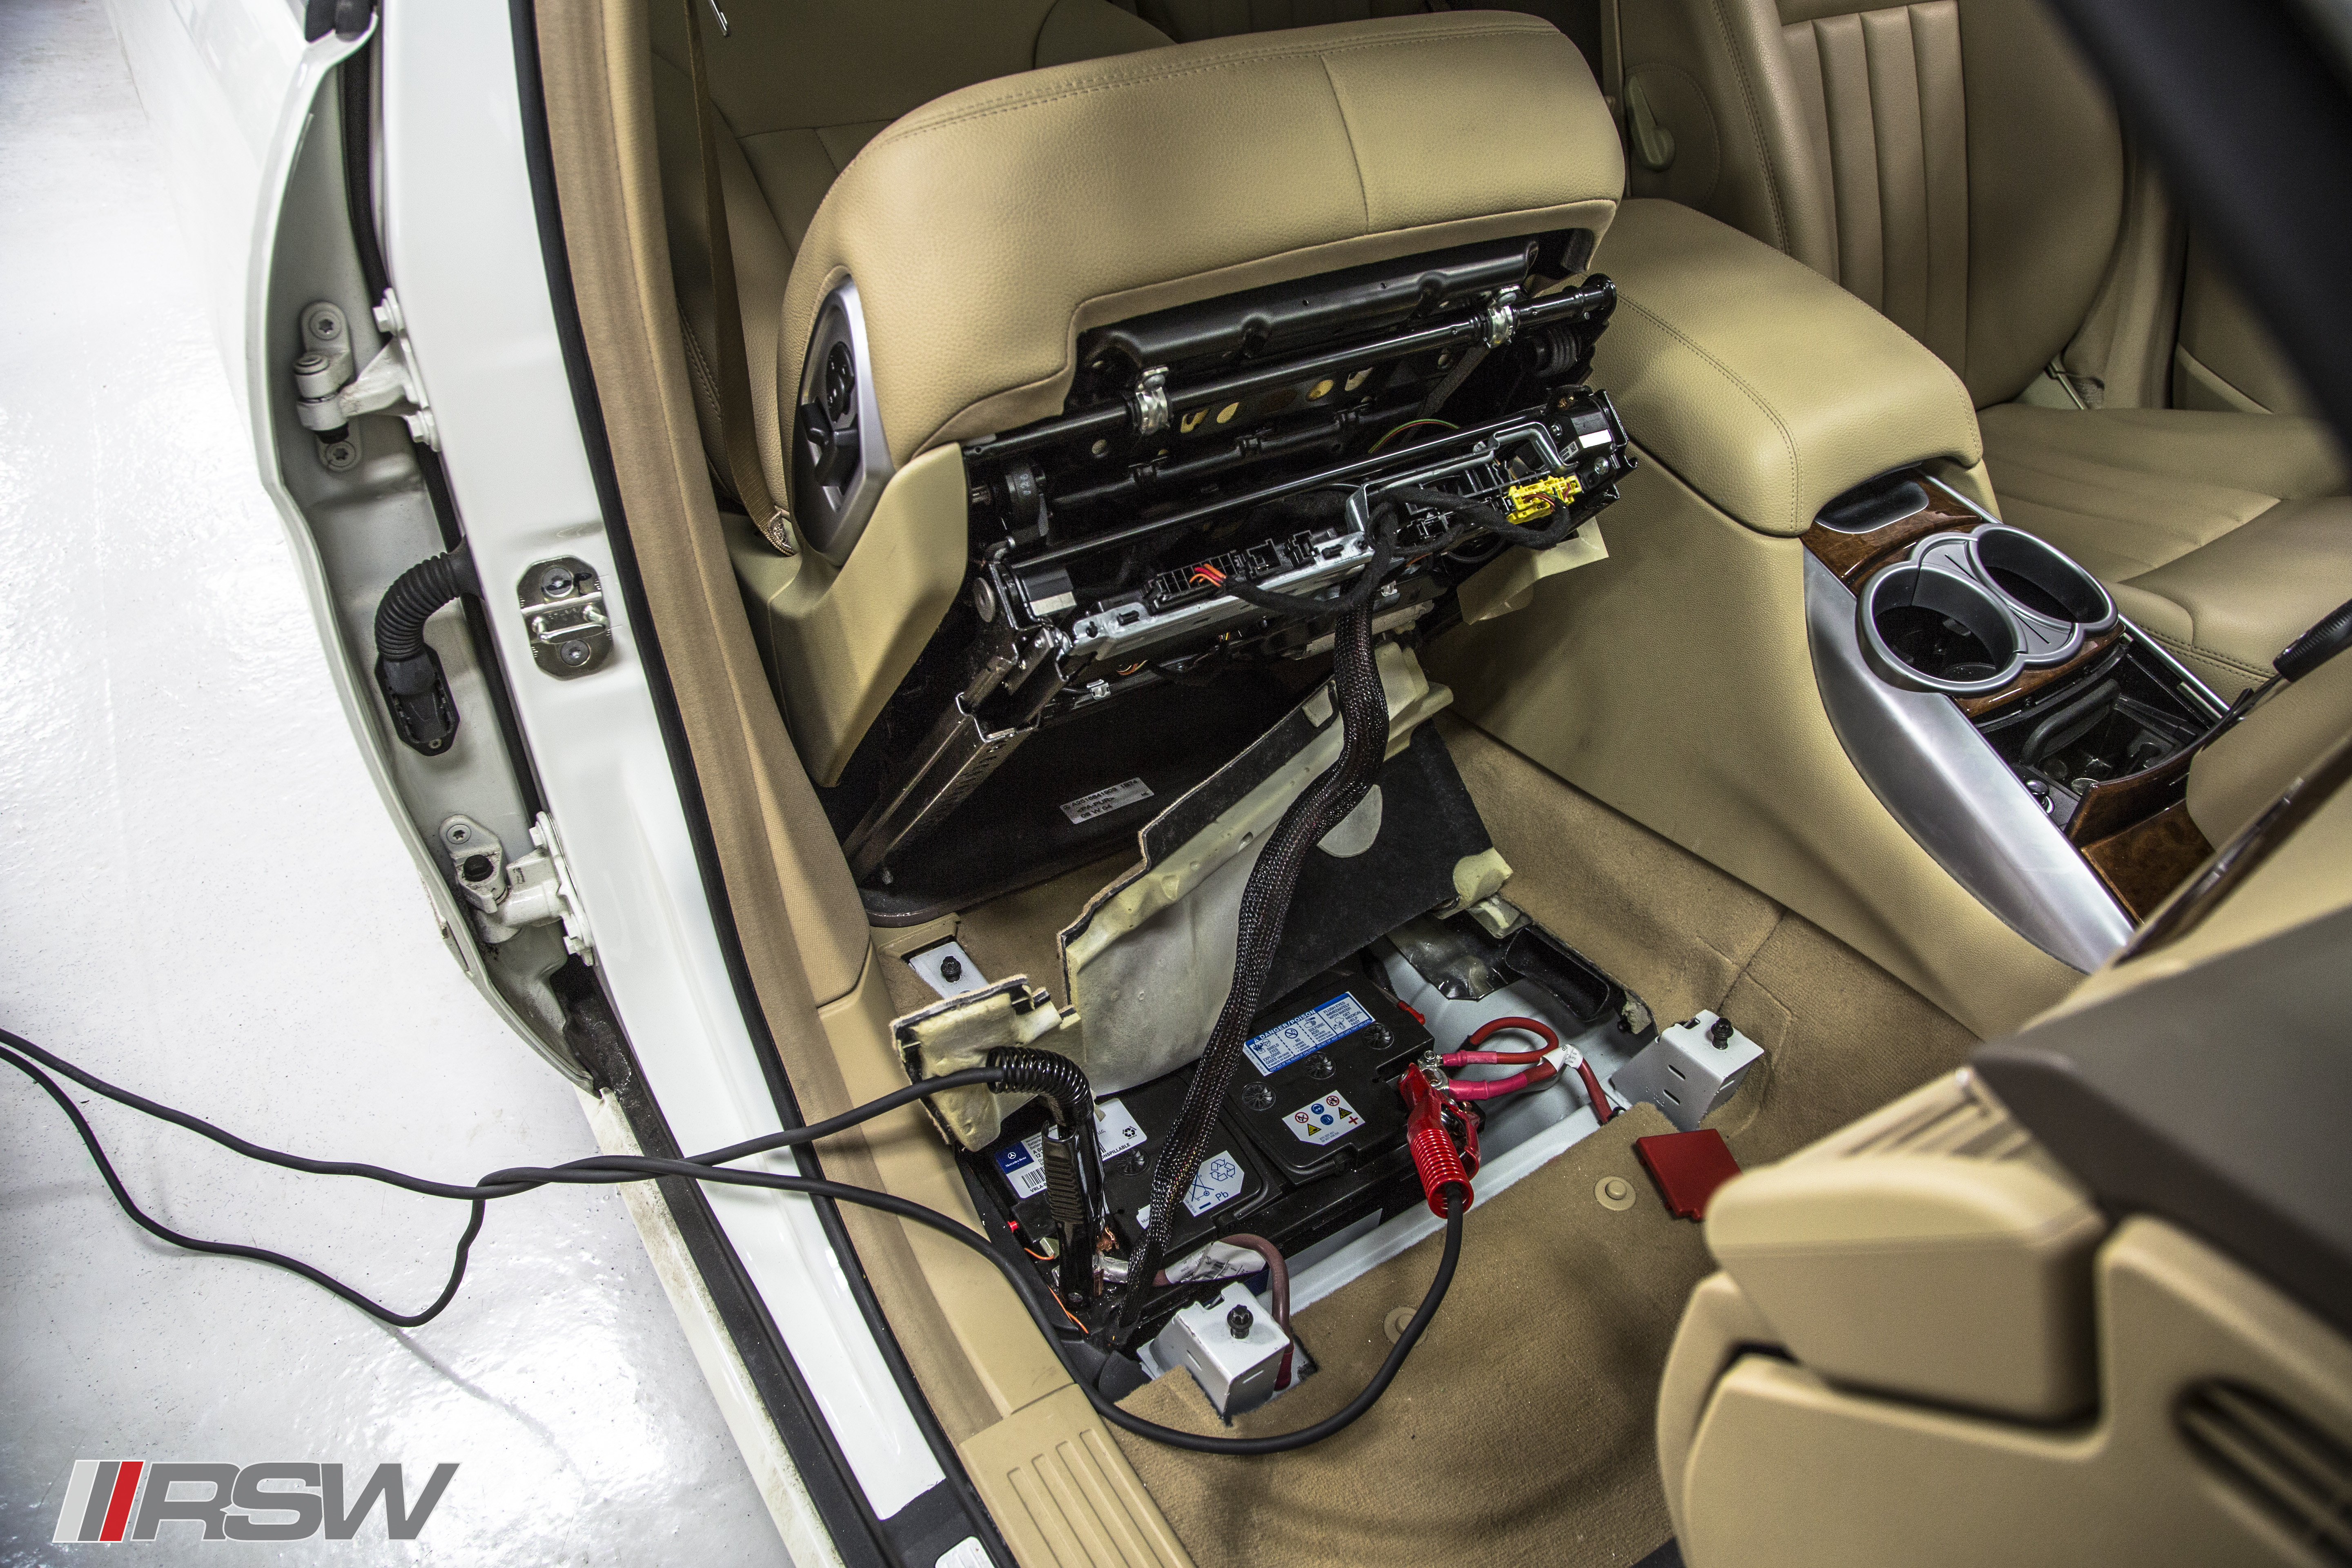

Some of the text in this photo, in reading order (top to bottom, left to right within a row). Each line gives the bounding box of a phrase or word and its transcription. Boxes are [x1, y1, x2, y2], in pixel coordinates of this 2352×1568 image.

[1326, 1003, 1350, 1016] IMMEDIATELY
[1339, 1007, 1352, 1015] WATER
[1345, 1010, 1363, 1020] MEDICAL
[1259, 1009, 1316, 1039] DANGER/POISON
[1308, 1022, 1325, 1032] SULFURIC
[1263, 1051, 1281, 1062] EXPLOSIVE
[1005, 1156, 1027, 1167] Mercedes-Benz
[1215, 1191, 1229, 1201] Pb
